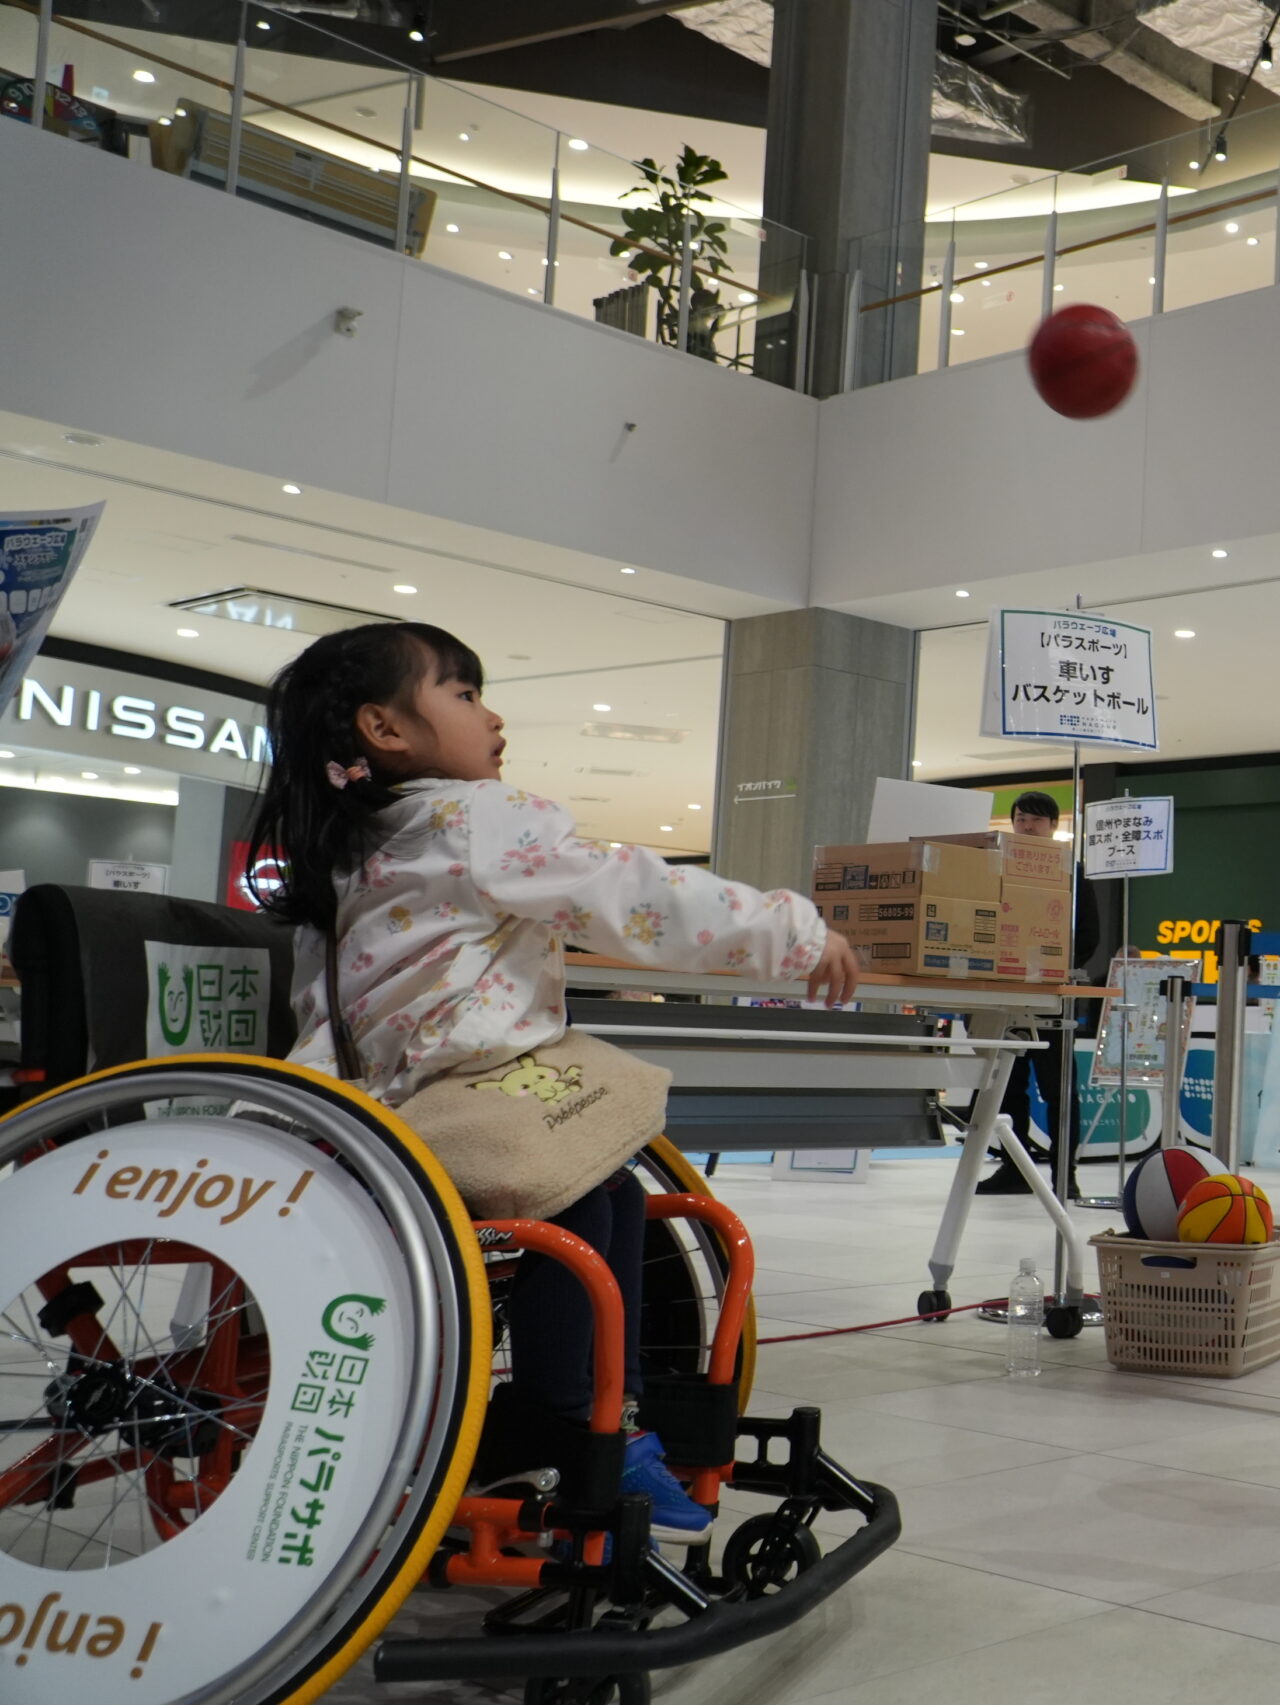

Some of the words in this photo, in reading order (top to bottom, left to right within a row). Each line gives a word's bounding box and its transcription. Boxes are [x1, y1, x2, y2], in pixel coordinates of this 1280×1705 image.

[1058, 660, 1114, 684] 車いす
[1012, 684, 1149, 715] バスケットボール
[197, 964, 260, 1002] 日本
[73, 1150, 109, 1195] i
[105, 1158, 277, 1226] enjoy
[328, 1354, 370, 1418] 日本
[294, 1423, 309, 1443] THE
[280, 1445, 302, 1489] NIPPON
[278, 1426, 344, 1567] パラサポ
[260, 1490, 289, 1563] FOUNDATION
